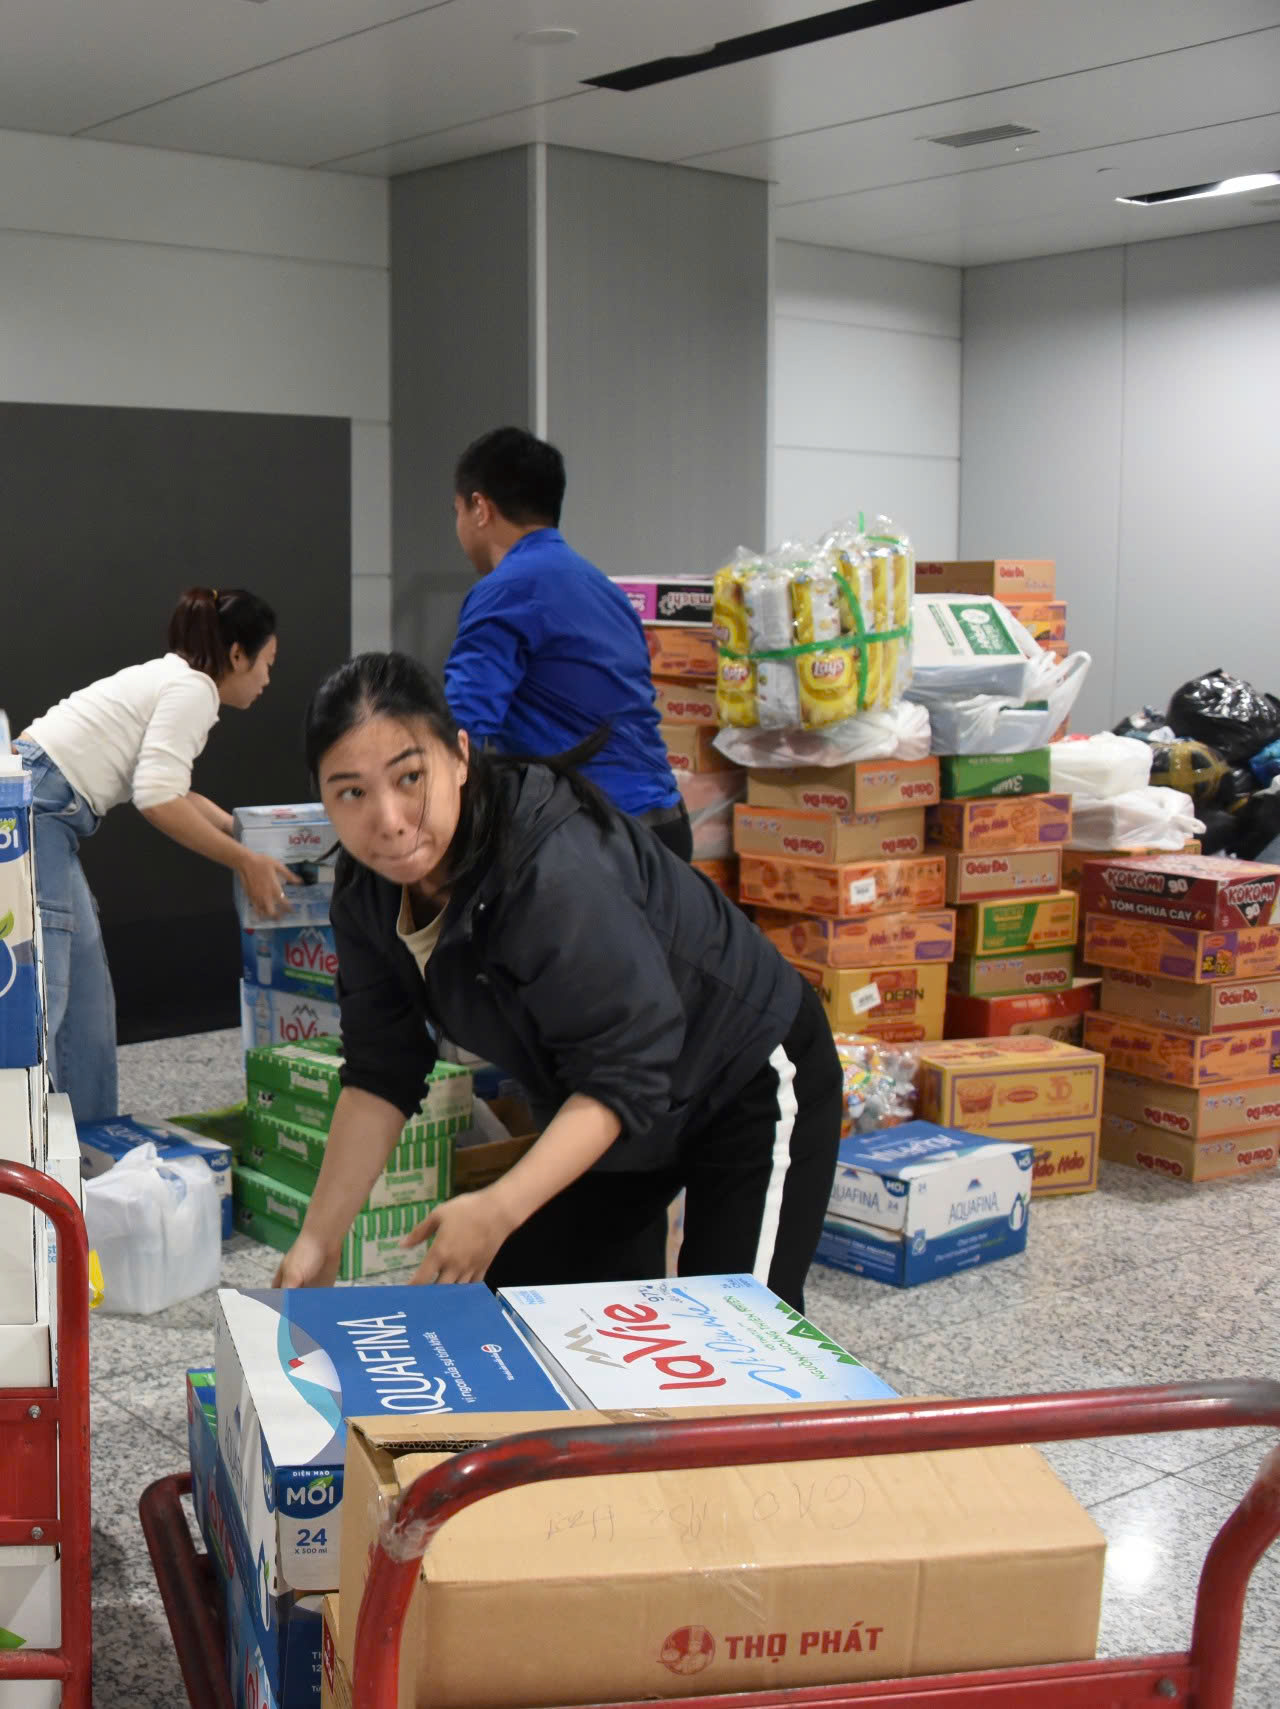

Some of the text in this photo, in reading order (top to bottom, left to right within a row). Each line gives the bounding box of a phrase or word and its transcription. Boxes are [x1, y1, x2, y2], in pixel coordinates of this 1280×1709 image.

[1103, 867, 1189, 894] KOKOMI 90
[1224, 881, 1276, 907] KOKOMI
[1135, 904, 1168, 917] CHUA
[1168, 908, 1193, 921] CAY
[1244, 902, 1260, 921] 90
[284, 936, 339, 975] laVie
[948, 1192, 1001, 1226] AQUAFINA
[596, 1303, 727, 1391] laVie
[295, 1527, 328, 1548] 24
[302, 1547, 317, 1555] 500
[724, 1620, 884, 1664] THỌ PHÁT
